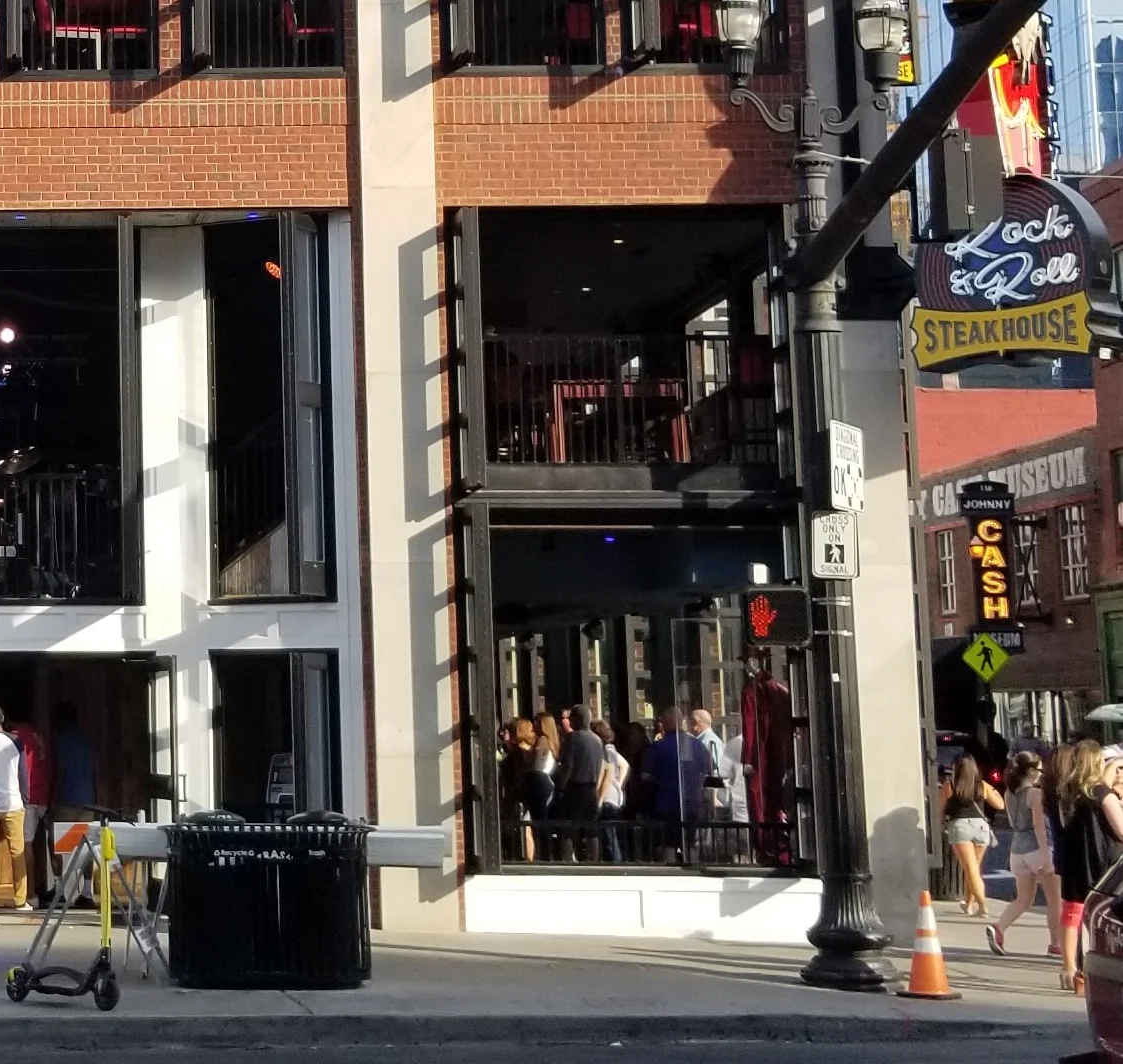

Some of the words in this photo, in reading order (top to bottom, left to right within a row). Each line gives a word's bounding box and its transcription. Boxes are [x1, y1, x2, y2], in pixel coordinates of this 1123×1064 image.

[975, 252, 1081, 305] Roll
[924, 303, 1079, 354] STEAKHOUSE
[833, 464, 847, 497] OK
[932, 474, 983, 516] CA
[987, 446, 1086, 499] MUSEUM
[963, 498, 1011, 510] JOHNNY
[819, 515, 849, 524] CROSS
[822, 524, 846, 534] ONLY
[828, 533, 841, 543] ON
[820, 564, 849, 574] SIGNAL
[977, 520, 1010, 620] CASH
[973, 632, 1022, 647] SEUM
